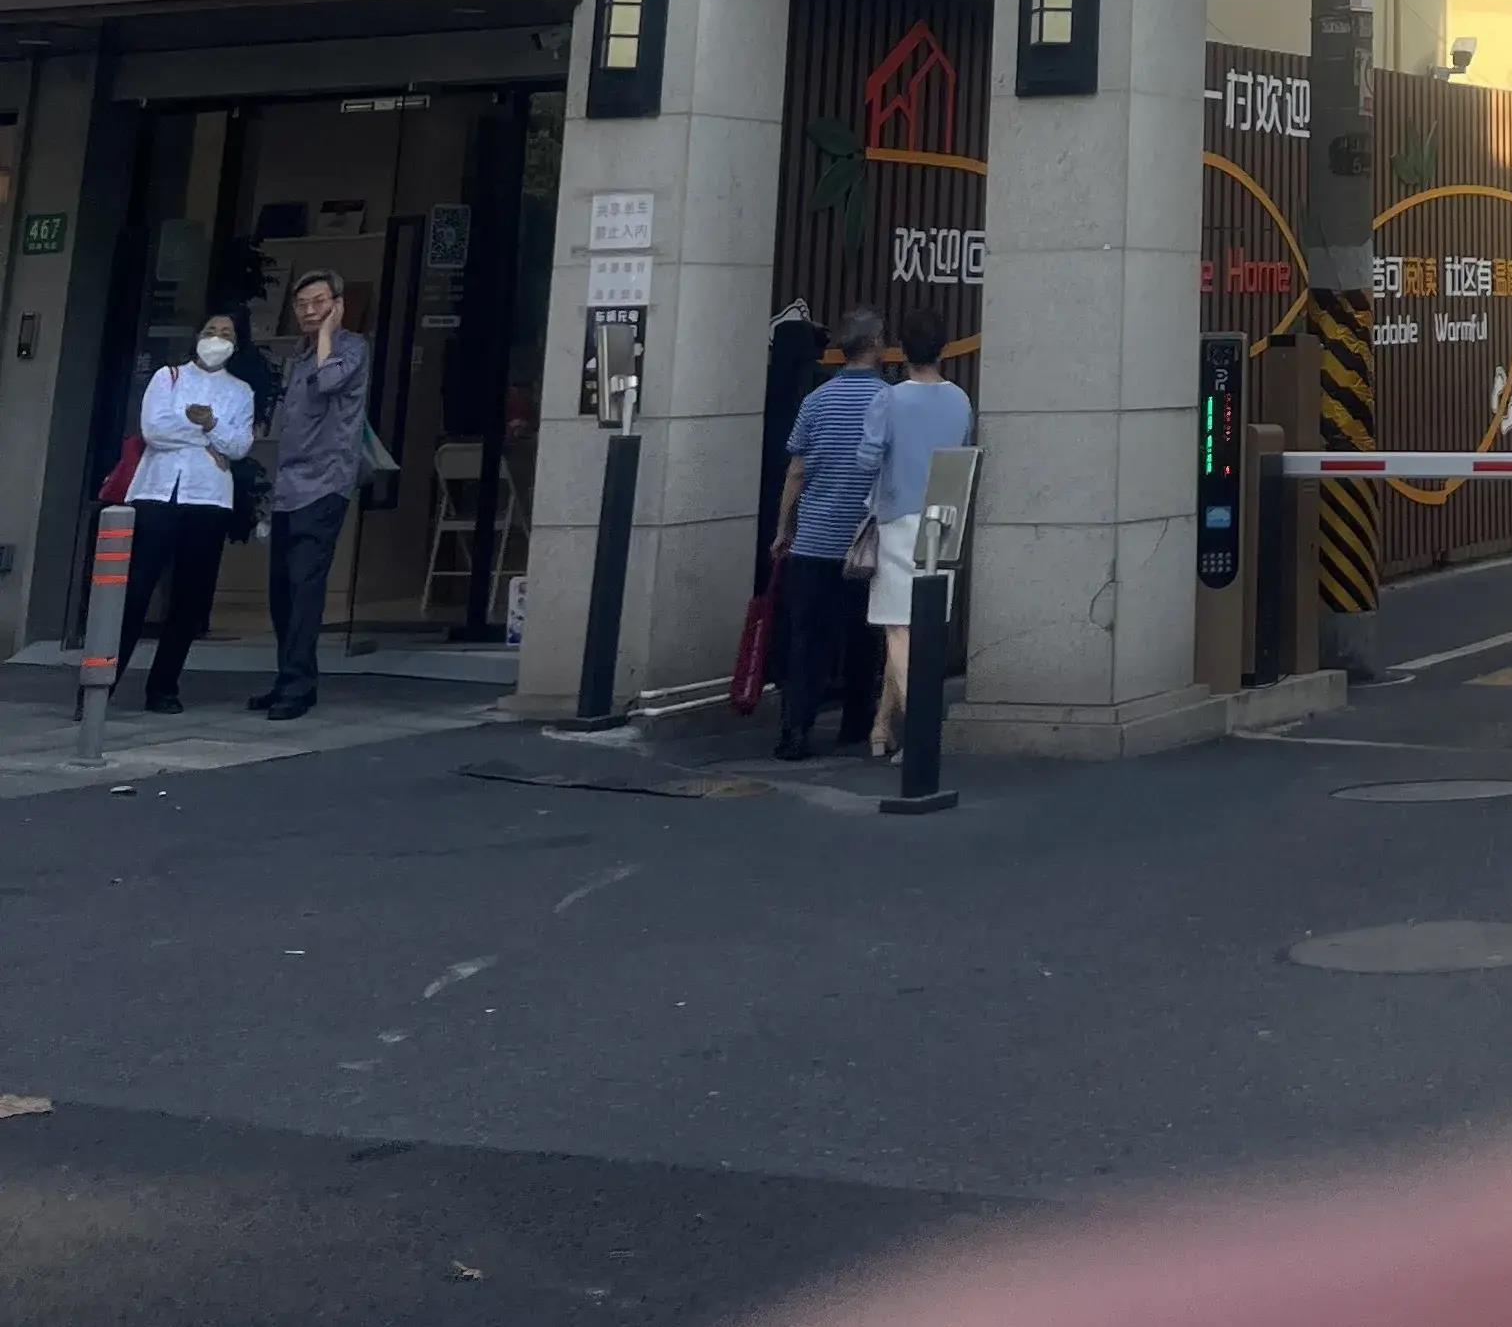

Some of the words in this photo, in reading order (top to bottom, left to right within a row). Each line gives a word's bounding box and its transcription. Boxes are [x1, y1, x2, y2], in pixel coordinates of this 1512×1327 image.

[29, 218, 61, 240] 467
[1227, 246, 1291, 293] Home
[1434, 311, 1488, 344] Warmful
